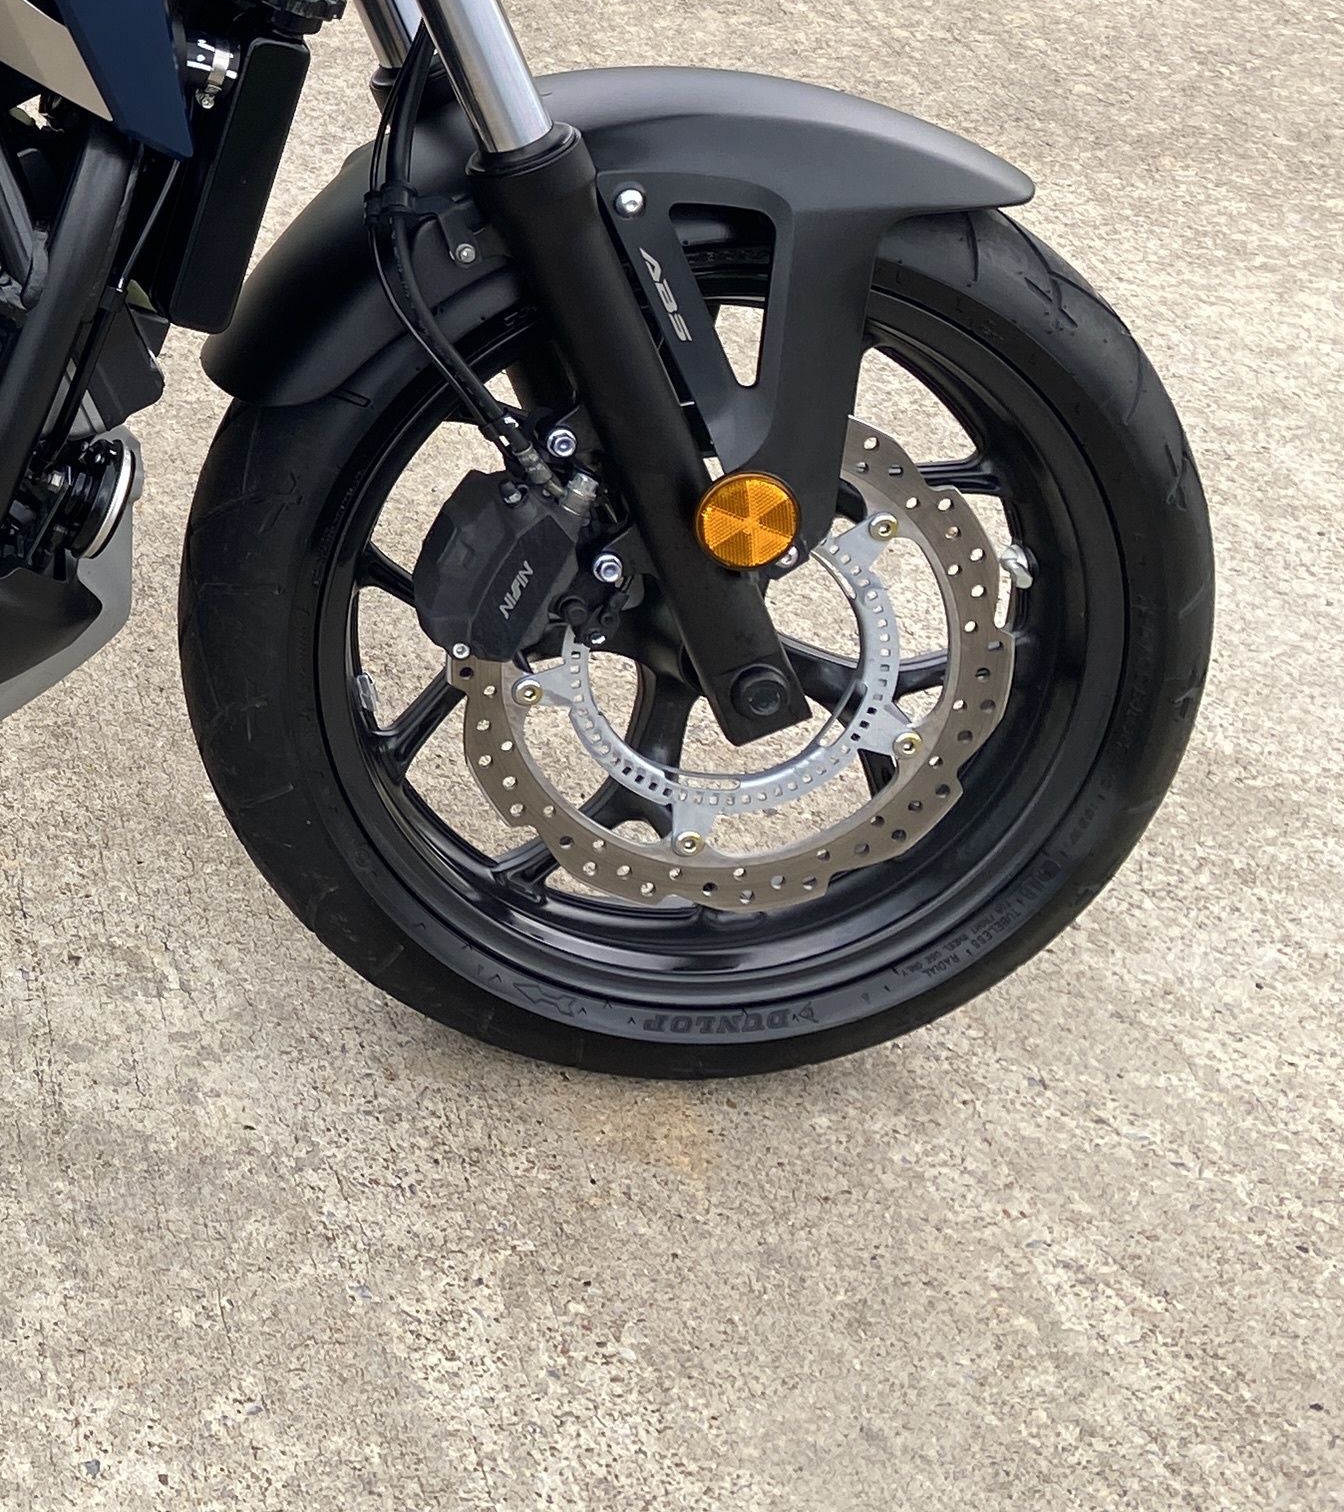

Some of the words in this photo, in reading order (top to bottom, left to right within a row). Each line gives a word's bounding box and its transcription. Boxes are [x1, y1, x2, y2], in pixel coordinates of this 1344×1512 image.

[639, 247, 693, 342] ABS
[924, 953, 960, 978] RADIAL
[643, 1008, 790, 1035] DUNLOP
